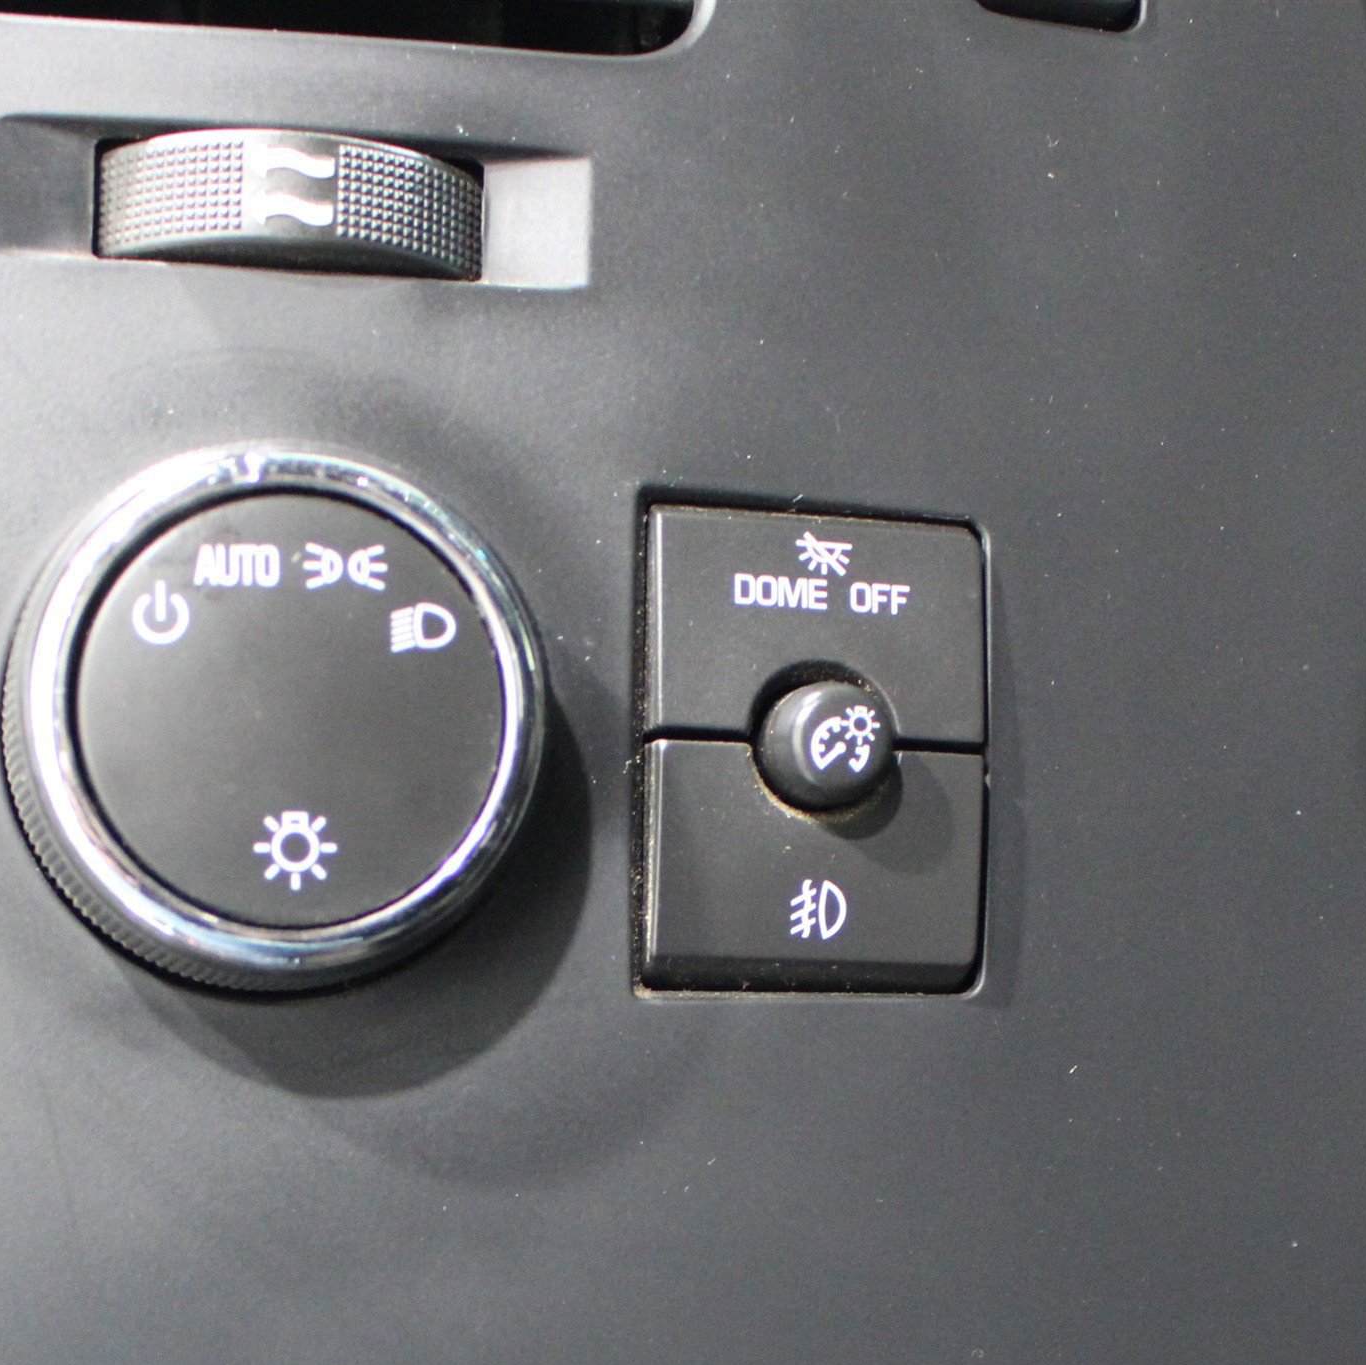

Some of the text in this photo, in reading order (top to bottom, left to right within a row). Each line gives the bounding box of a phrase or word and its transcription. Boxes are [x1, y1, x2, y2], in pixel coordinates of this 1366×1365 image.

[193, 543, 281, 588] AUTO
[733, 573, 911, 615] DOME OFF
